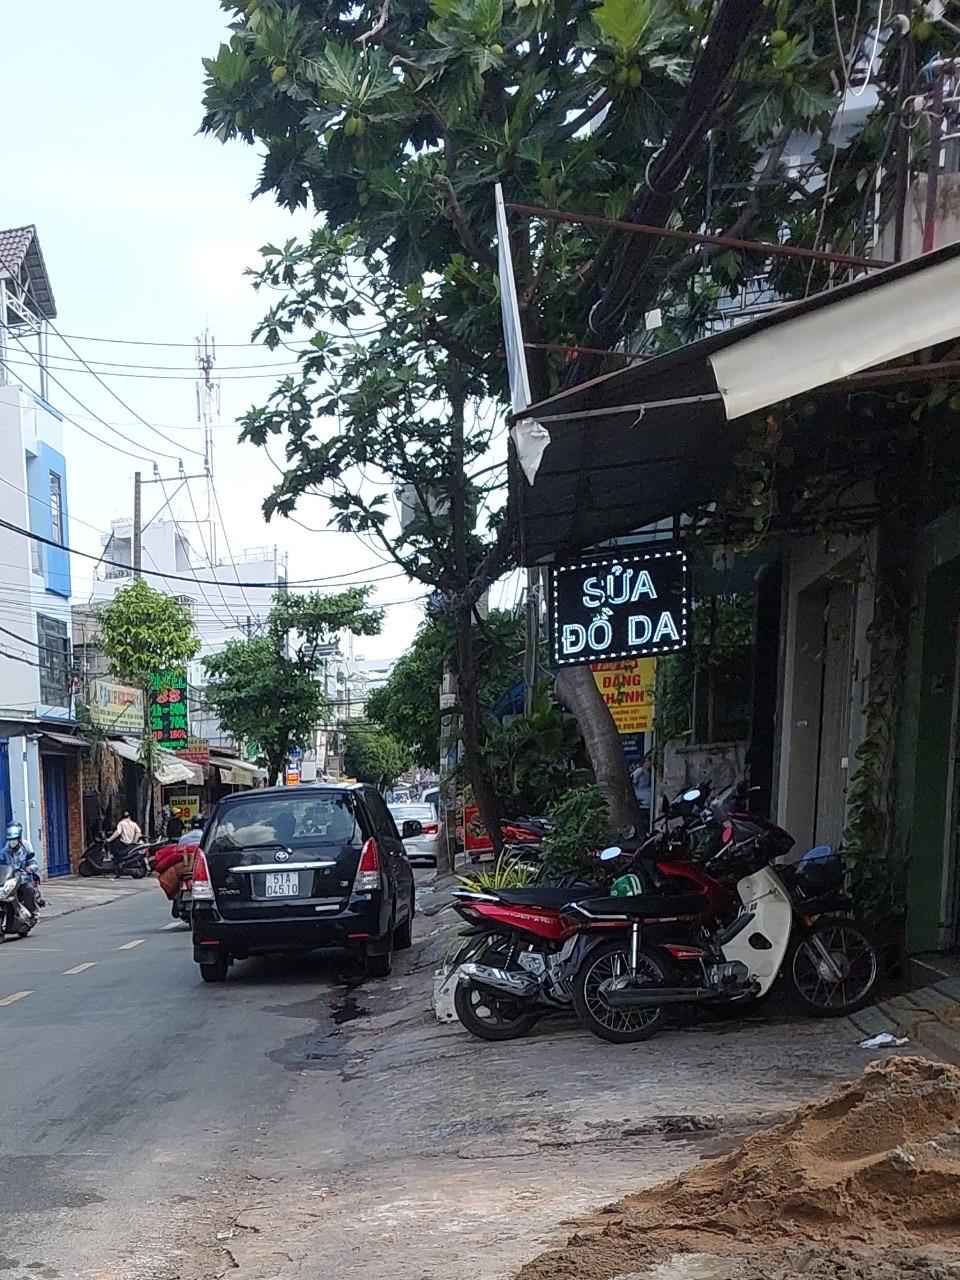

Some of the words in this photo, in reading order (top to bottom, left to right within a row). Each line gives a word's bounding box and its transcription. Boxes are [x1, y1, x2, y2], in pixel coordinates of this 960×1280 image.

[582, 565, 658, 608] SỬA
[562, 607, 614, 654] ĐỒ
[628, 611, 680, 646] DA
[267, 884, 298, 896] 045.10
[273, 874, 291, 885] 51A
